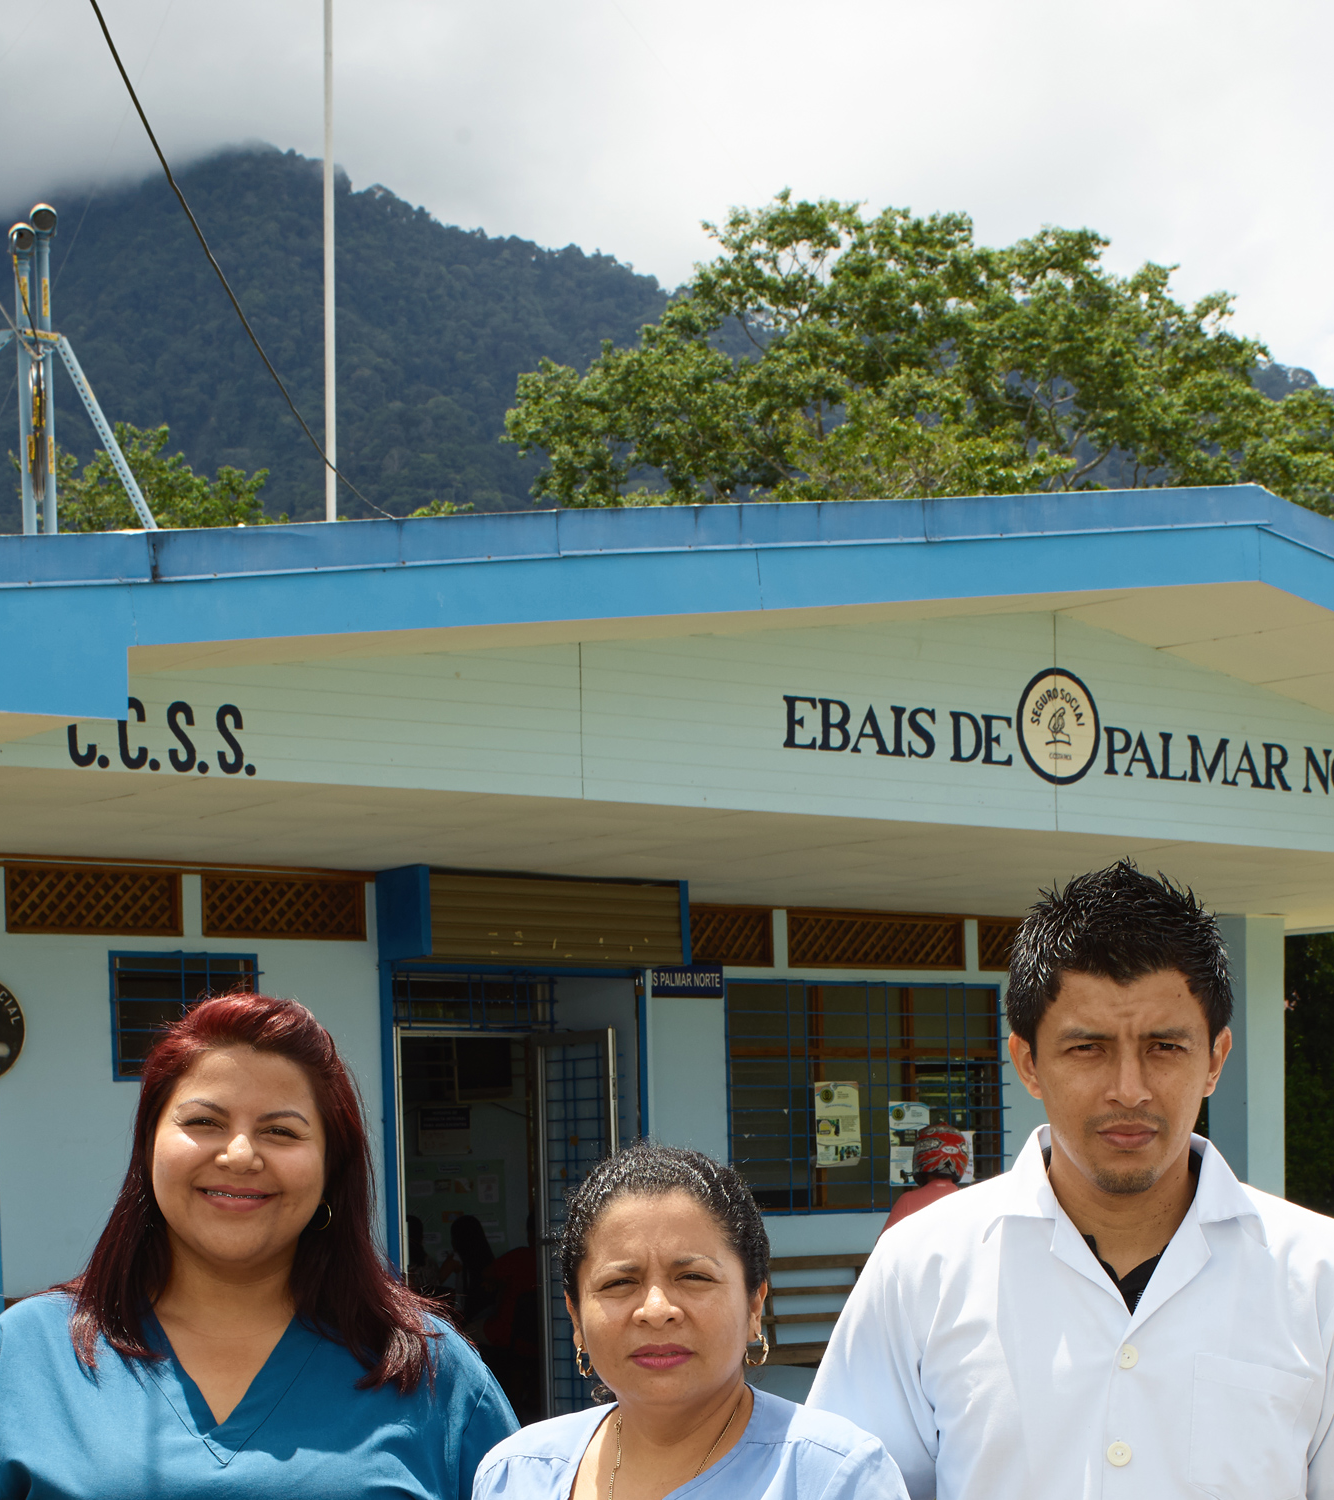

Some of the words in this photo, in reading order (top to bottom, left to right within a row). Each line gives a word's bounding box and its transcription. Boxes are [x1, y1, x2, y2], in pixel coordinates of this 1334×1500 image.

[1030, 687, 1058, 726] SEGURO
[67, 697, 257, 777] C.C.S.S.
[782, 694, 936, 759] EBAIS
[949, 710, 1013, 766] DE
[1103, 726, 1292, 792] PALMAR
[659, 972, 693, 987] PALMAR
[693, 973, 721, 988] NORTE
